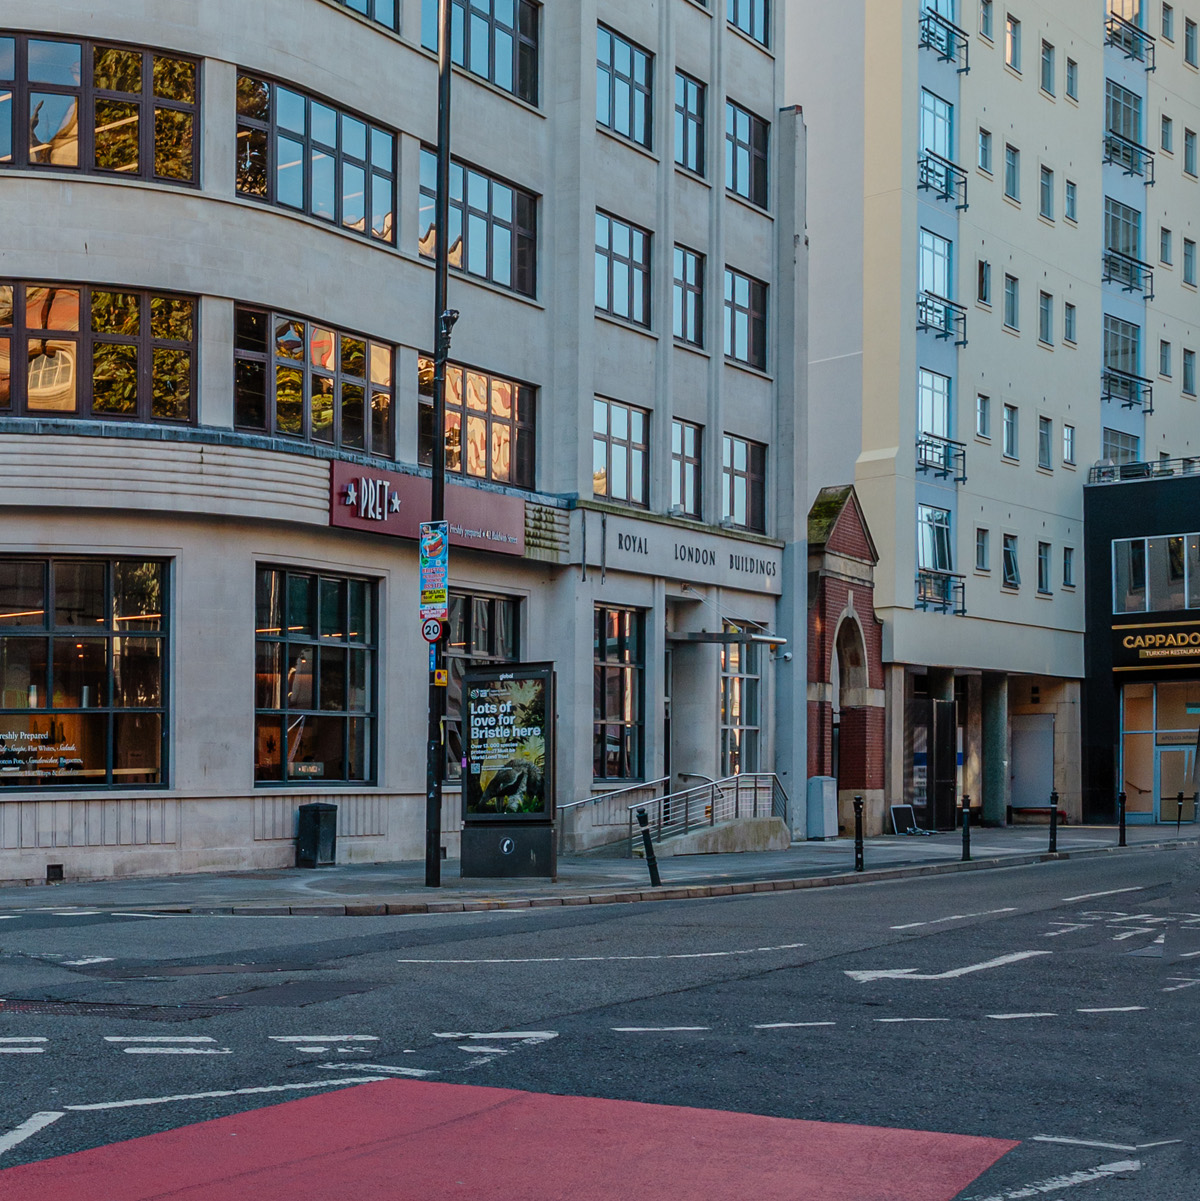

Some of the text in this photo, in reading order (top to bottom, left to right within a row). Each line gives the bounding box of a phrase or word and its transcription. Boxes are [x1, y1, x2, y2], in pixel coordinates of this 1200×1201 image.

[361, 477, 390, 521] PRET
[618, 533, 776, 576] ROYAL LONDON BUILDINGS
[425, 624, 439, 635] 20
[1145, 649, 1170, 657] TURKISH
[471, 700, 512, 714] Lots of
[471, 714, 516, 726] love for
[20, 731, 49, 741] Prepared
[471, 726, 541, 739] Bristle here
